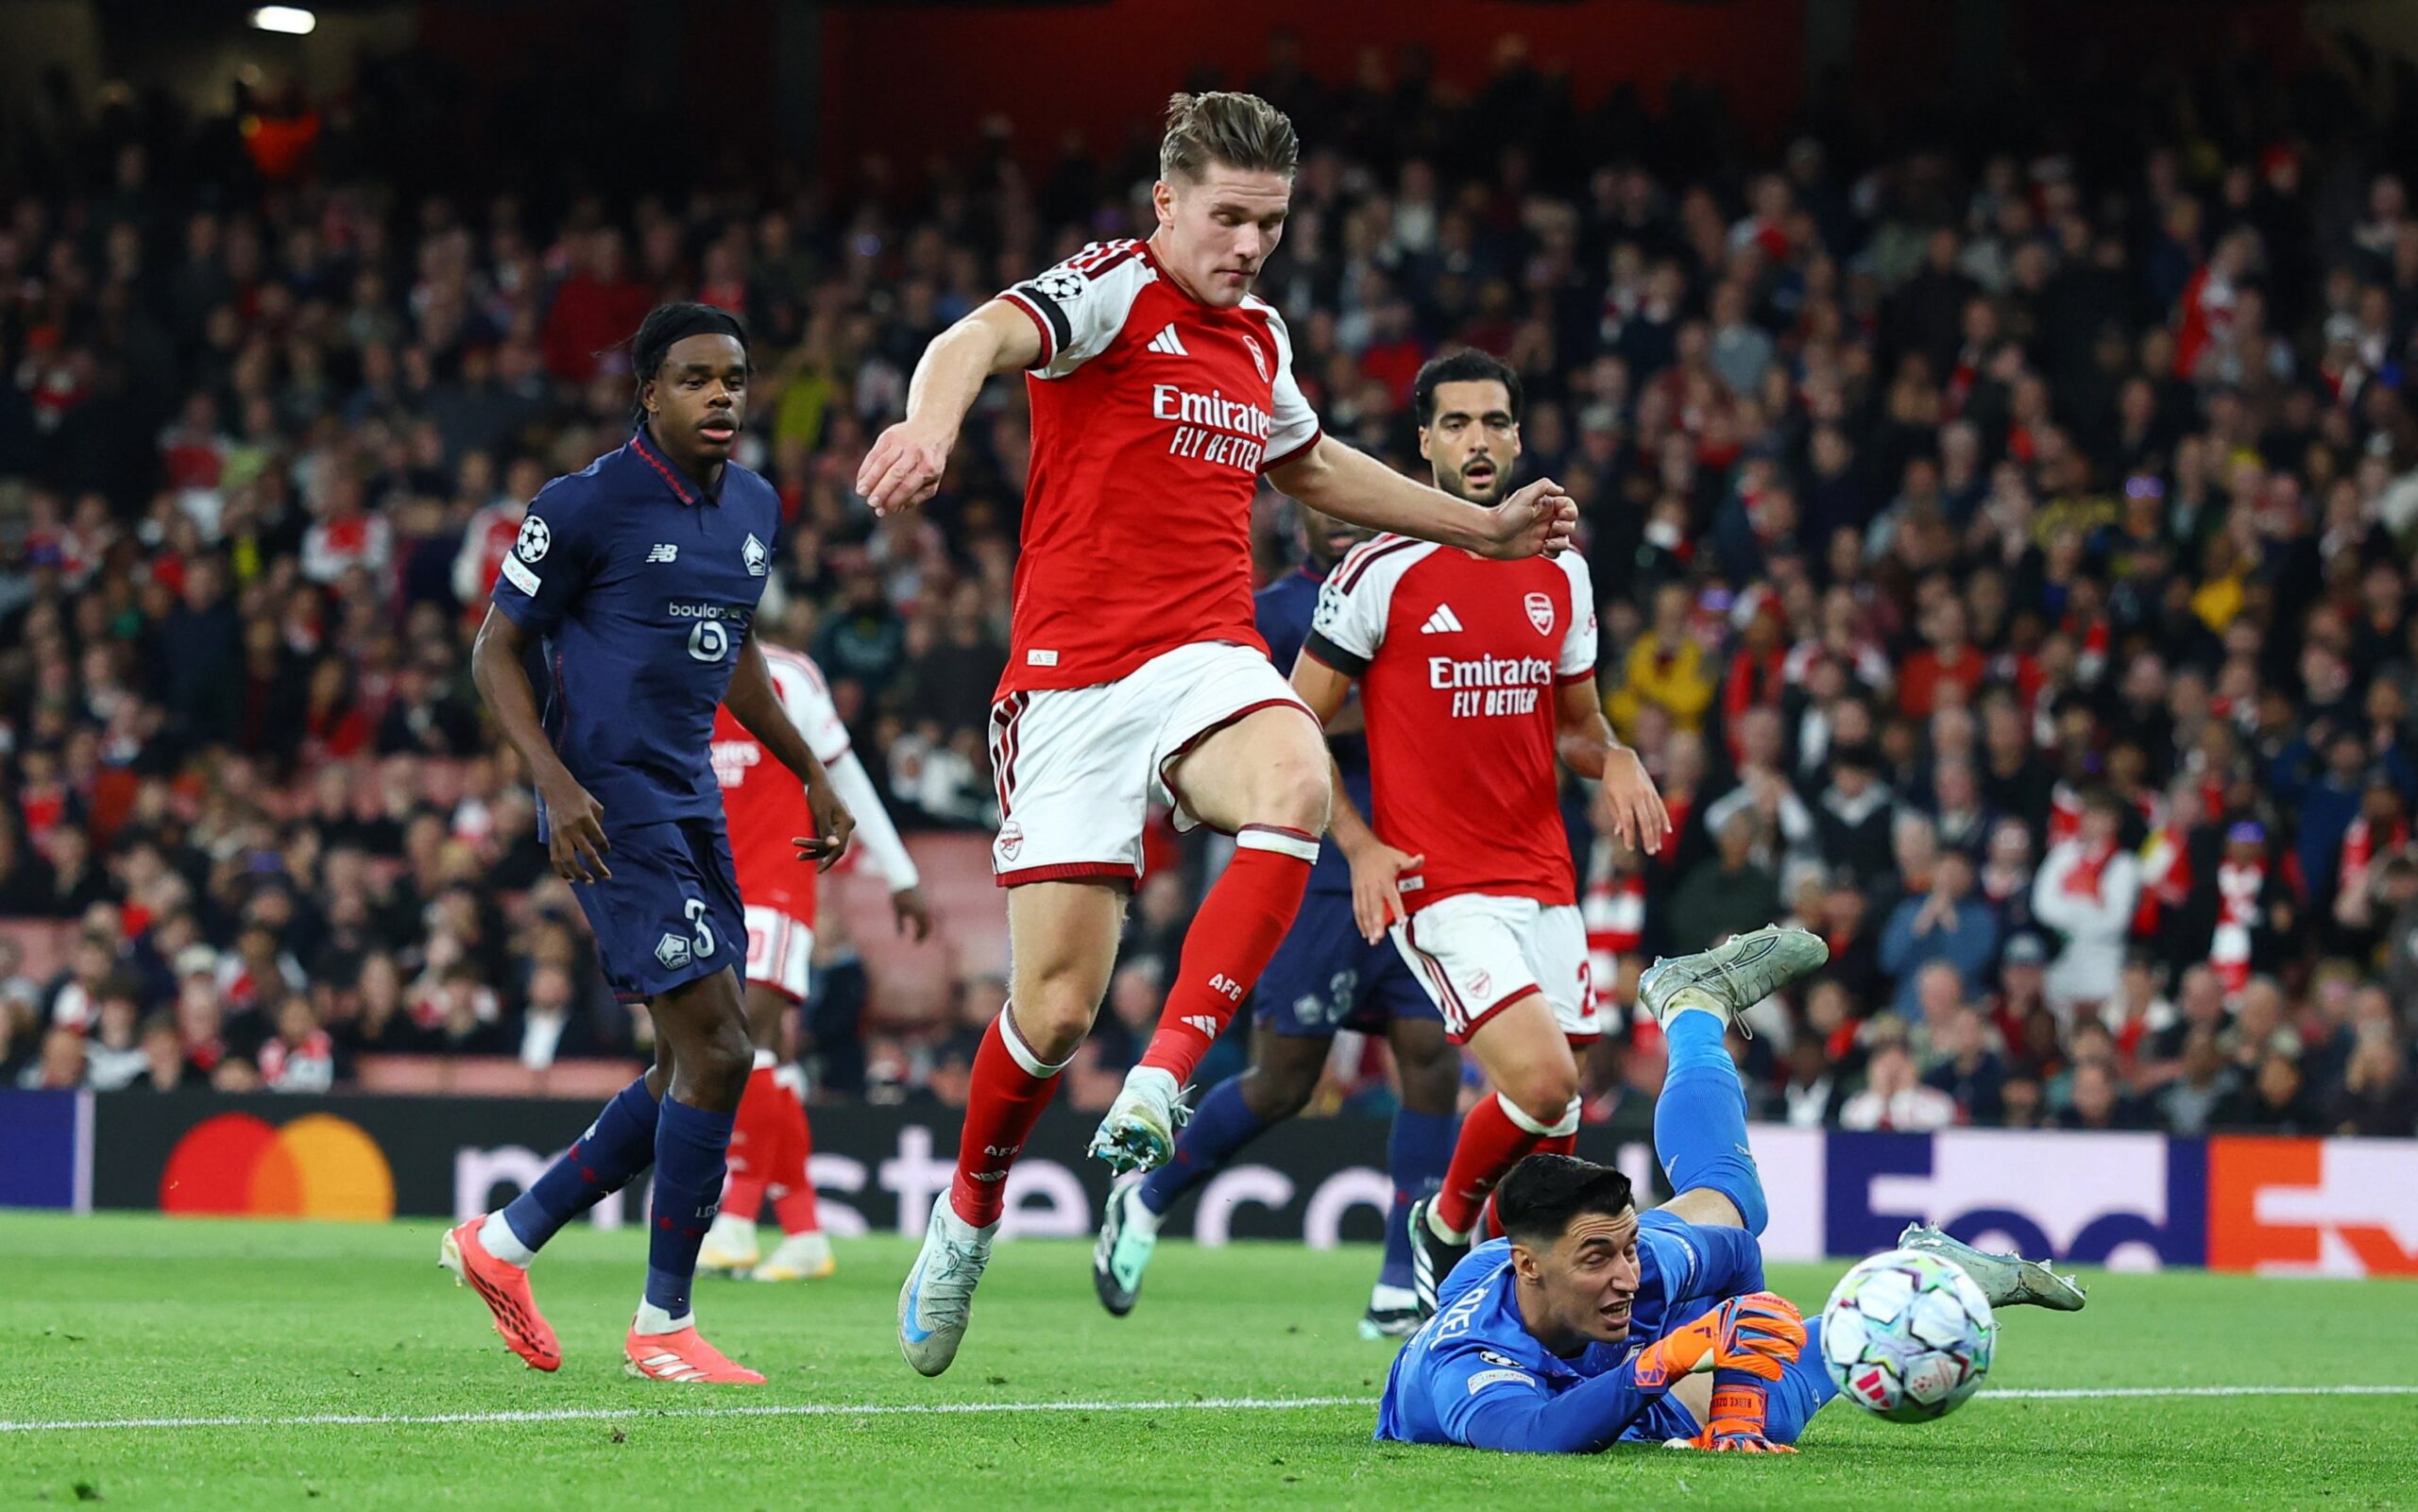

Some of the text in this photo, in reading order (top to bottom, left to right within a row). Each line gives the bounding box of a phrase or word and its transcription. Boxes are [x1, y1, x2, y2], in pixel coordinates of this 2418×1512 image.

[1169, 426, 1262, 474] FLY BETTER
[1428, 653, 1552, 688] Emirates
[1453, 688, 1539, 718] FLY BETTER
[1208, 973, 1243, 1001] AFC
